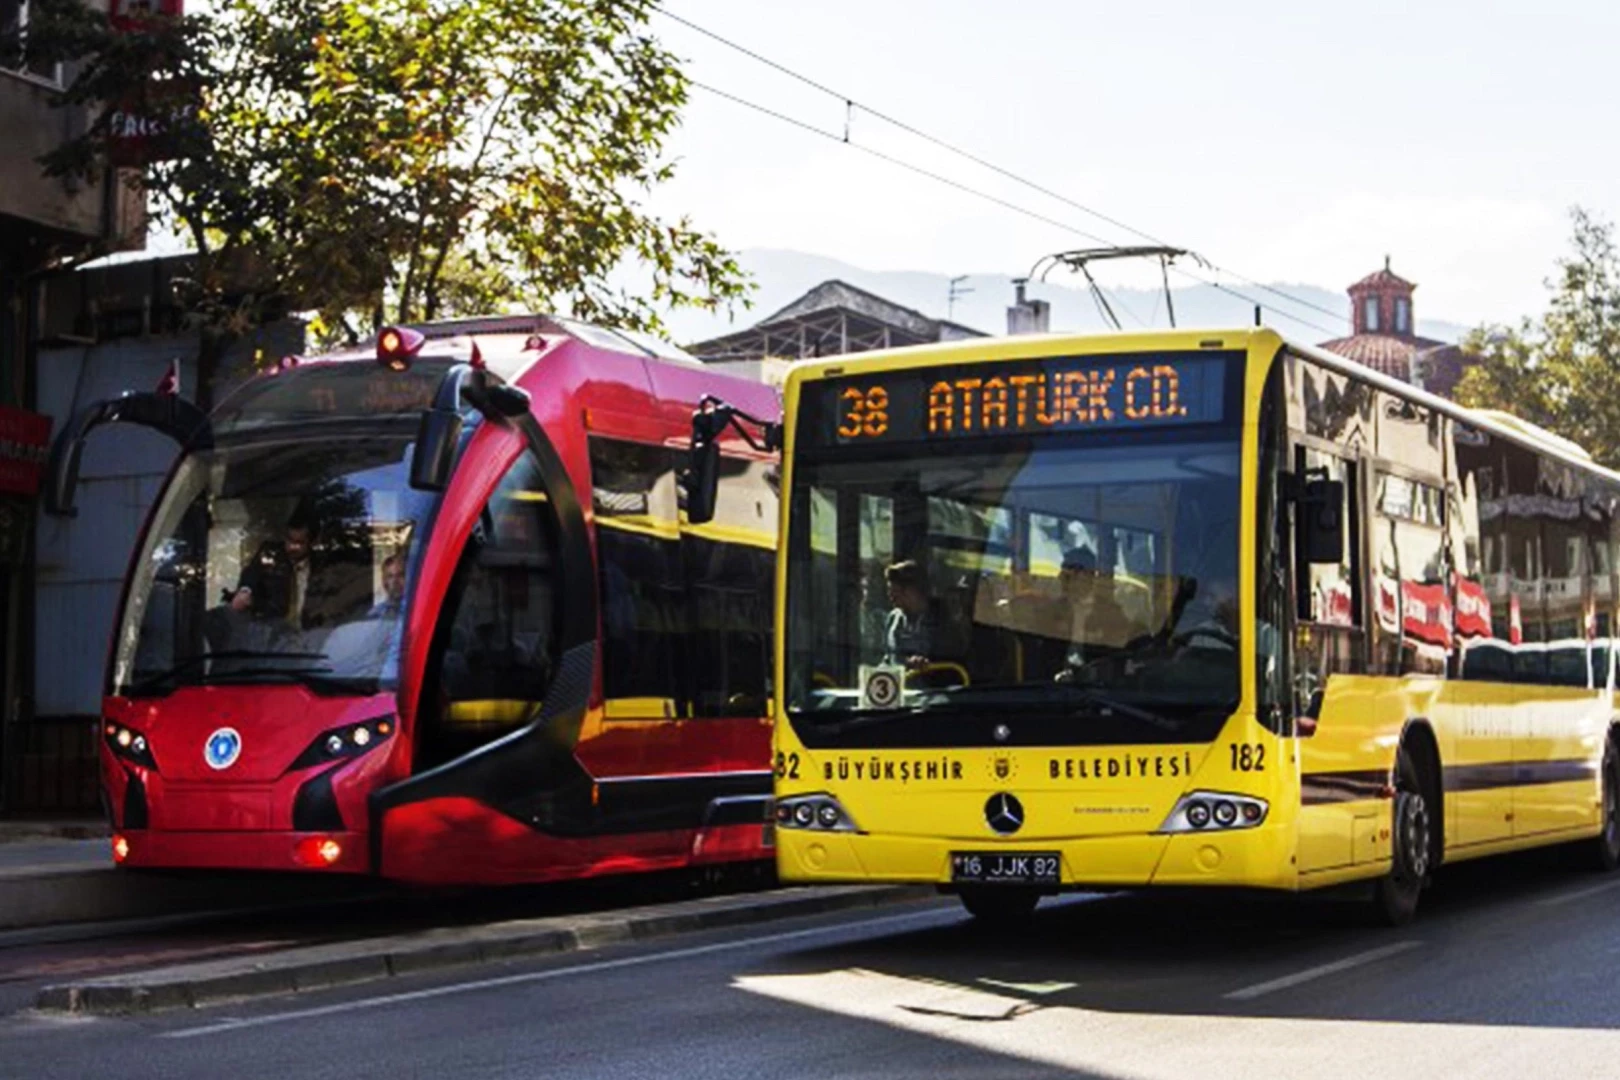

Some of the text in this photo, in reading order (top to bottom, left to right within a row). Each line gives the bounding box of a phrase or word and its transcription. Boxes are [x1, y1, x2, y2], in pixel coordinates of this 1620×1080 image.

[838, 385, 889, 437] 38
[1125, 365, 1187, 419] CD.
[876, 679, 890, 700] 3
[824, 752, 1191, 784] BÜYÜKŞEHİR BELEDİYESİ
[1229, 743, 1265, 772] 182
[963, 855, 983, 875] 16
[990, 856, 1030, 876] JJK
